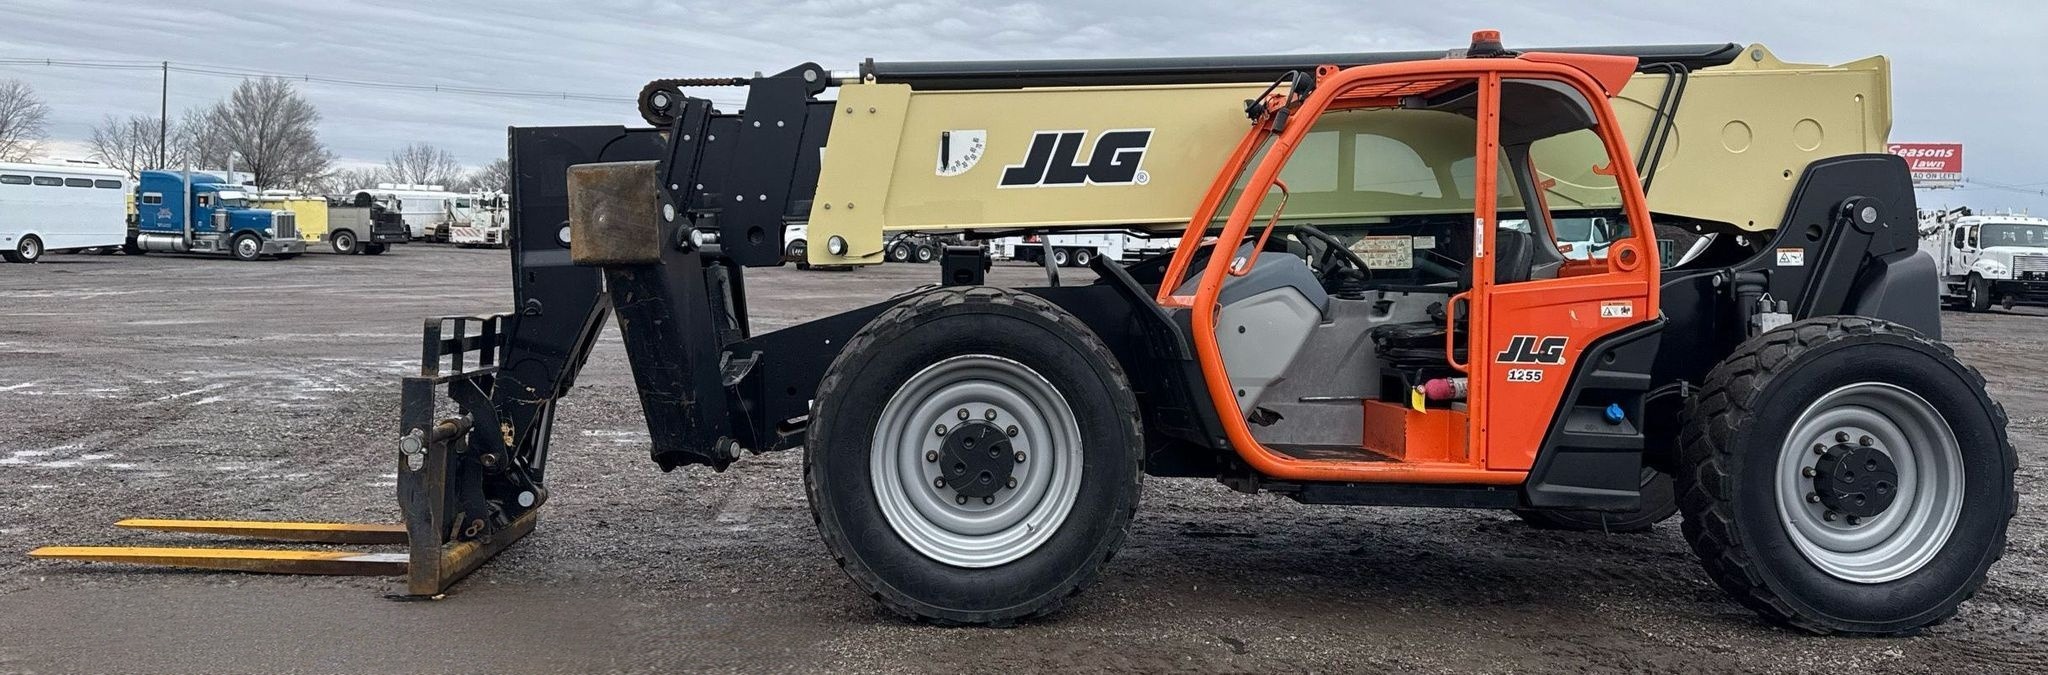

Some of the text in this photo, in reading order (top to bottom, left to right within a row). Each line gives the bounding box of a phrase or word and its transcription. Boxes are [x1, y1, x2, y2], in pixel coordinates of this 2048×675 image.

[1888, 145, 1954, 157] Seasons
[1000, 130, 1152, 186] JLG
[1912, 159, 1946, 170] Lawn
[1496, 336, 1567, 364] JLG
[1509, 370, 1542, 381] 1255
